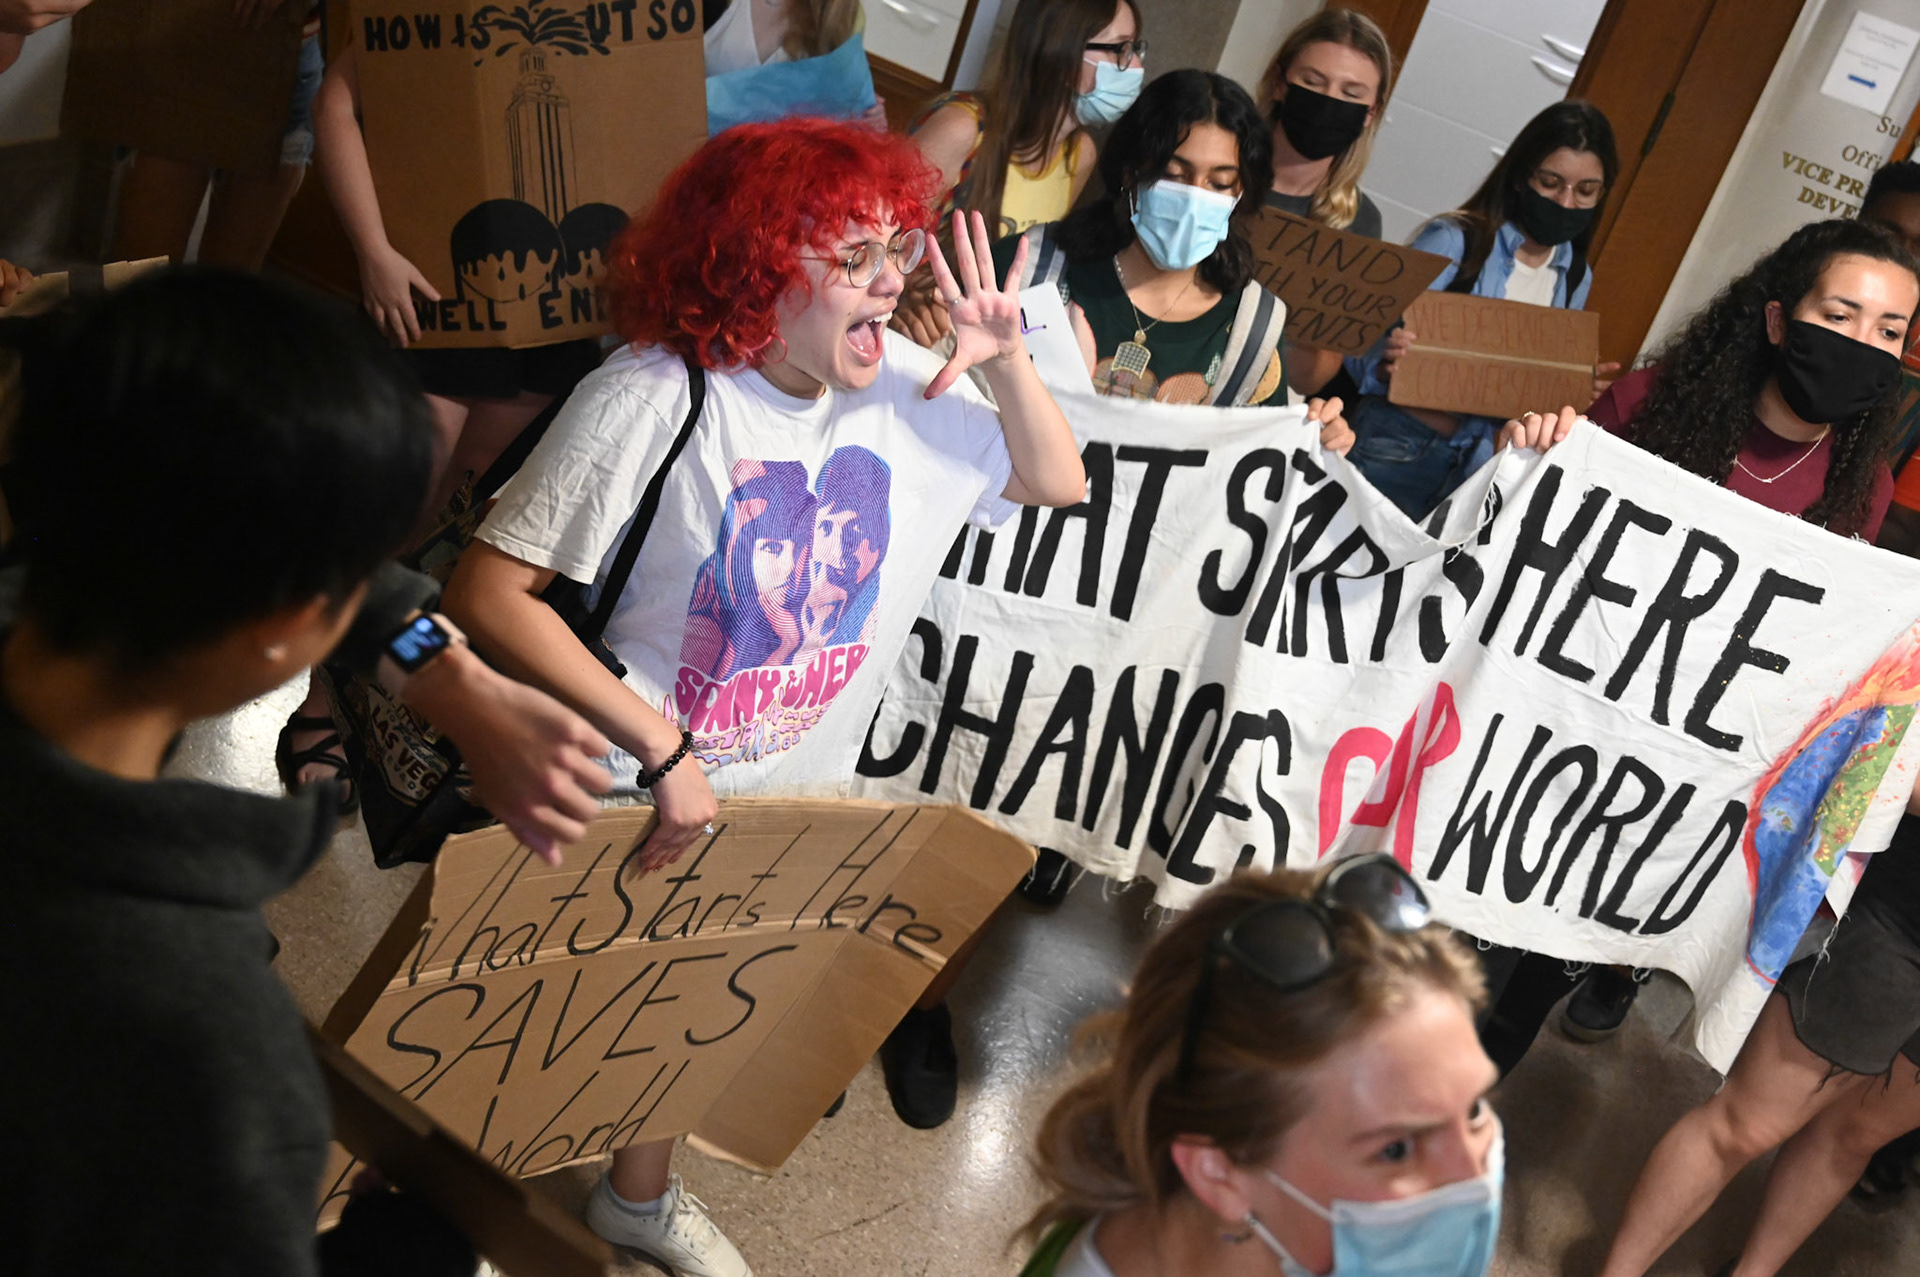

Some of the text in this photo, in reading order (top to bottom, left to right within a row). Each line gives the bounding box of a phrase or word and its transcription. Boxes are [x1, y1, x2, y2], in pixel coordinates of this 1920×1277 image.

[364, 14, 441, 52] HOW
[647, 0, 696, 41] SO
[1783, 152, 1834, 185] VICE
[1259, 211, 1404, 285] TAND
[415, 298, 507, 331] WELL
[1308, 277, 1397, 320] YOUR
[1411, 302, 1450, 342] WE
[1478, 463, 1826, 752] HERE
[372, 705, 399, 750] LAS
[675, 666, 781, 734] SONNY
[855, 617, 1293, 884] CHANGES
[1426, 713, 1748, 935] WORLD
[567, 822, 812, 957] Starts
[790, 807, 942, 959] Here
[387, 944, 799, 1102] SAVES
